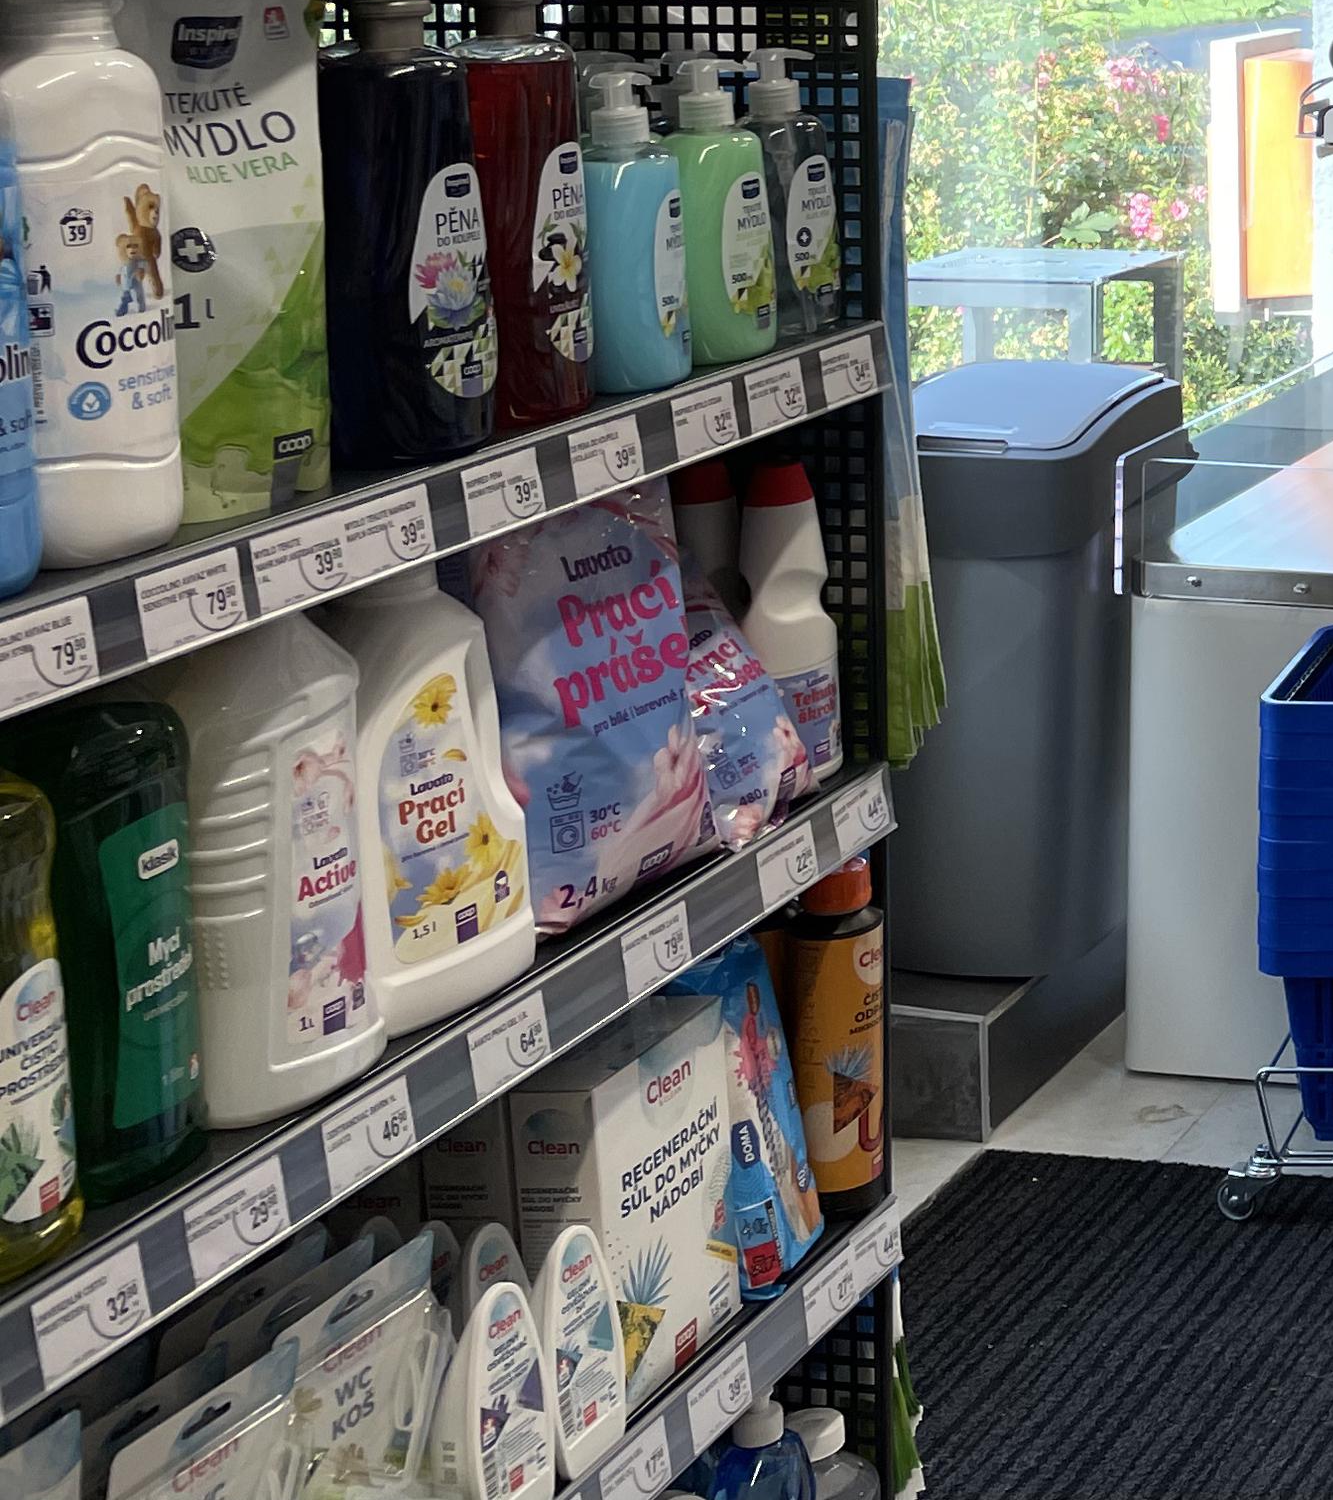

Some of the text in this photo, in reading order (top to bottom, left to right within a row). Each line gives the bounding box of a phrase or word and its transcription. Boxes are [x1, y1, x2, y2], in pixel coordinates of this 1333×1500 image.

[165, 81, 252, 115] TEKUTÉ
[163, 111, 296, 158] MÝDLO
[186, 152, 299, 185] ALOE VERA
[68, 224, 87, 242] 39
[435, 207, 480, 236] PĚNA
[173, 293, 200, 329] 1
[118, 361, 176, 393] sensitive
[132, 385, 172, 410] & soft
[560, 543, 634, 583] Lavato
[556, 559, 680, 648] Prací
[553, 613, 691, 730] práše
[398, 777, 467, 826] Prací
[410, 772, 455, 797] Lavato
[415, 811, 457, 844] Gel
[298, 859, 358, 903] Active
[559, 873, 598, 910] 2,4
[645, 1058, 693, 1106] Clean
[527, 1138, 581, 1157] Clean
[621, 1095, 720, 1193] REGENERAČNÍ
[620, 1122, 723, 1220] SŮL DO MYČKY
[648, 1164, 706, 1224] NÁDOBÍ
[562, 1252, 593, 1284] Clean
[487, 1308, 522, 1340] Clean
[333, 1364, 373, 1408] WC
